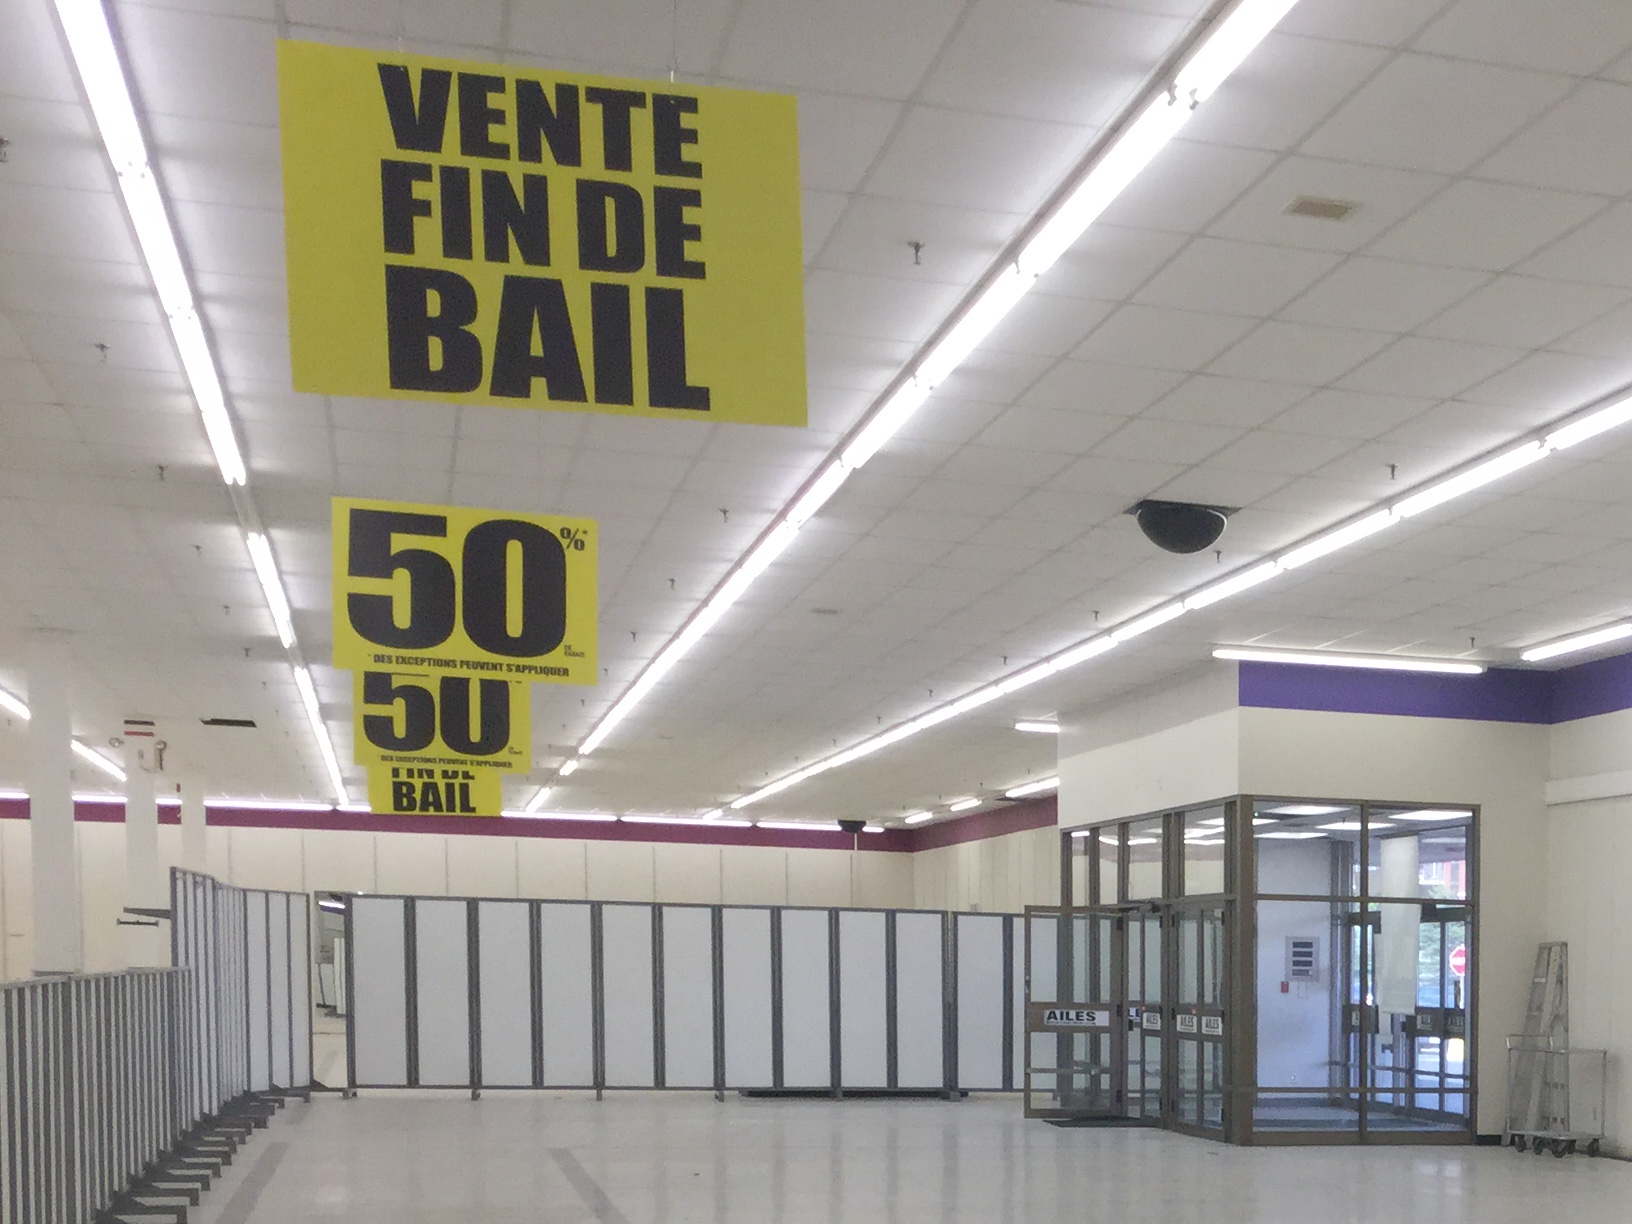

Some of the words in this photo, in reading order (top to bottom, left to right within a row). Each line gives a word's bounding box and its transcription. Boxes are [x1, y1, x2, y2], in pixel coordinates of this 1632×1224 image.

[377, 62, 703, 179] VENTE
[381, 158, 551, 267] FIN
[576, 178, 706, 280] DE
[384, 264, 711, 411] BAIL
[395, 655, 457, 668] EXCEPTIONS
[460, 659, 503, 672] PEUVENT
[506, 662, 569, 677] S'APPLIQUER
[392, 781, 476, 813] BAIL
[1047, 1010, 1096, 1022] AILES
